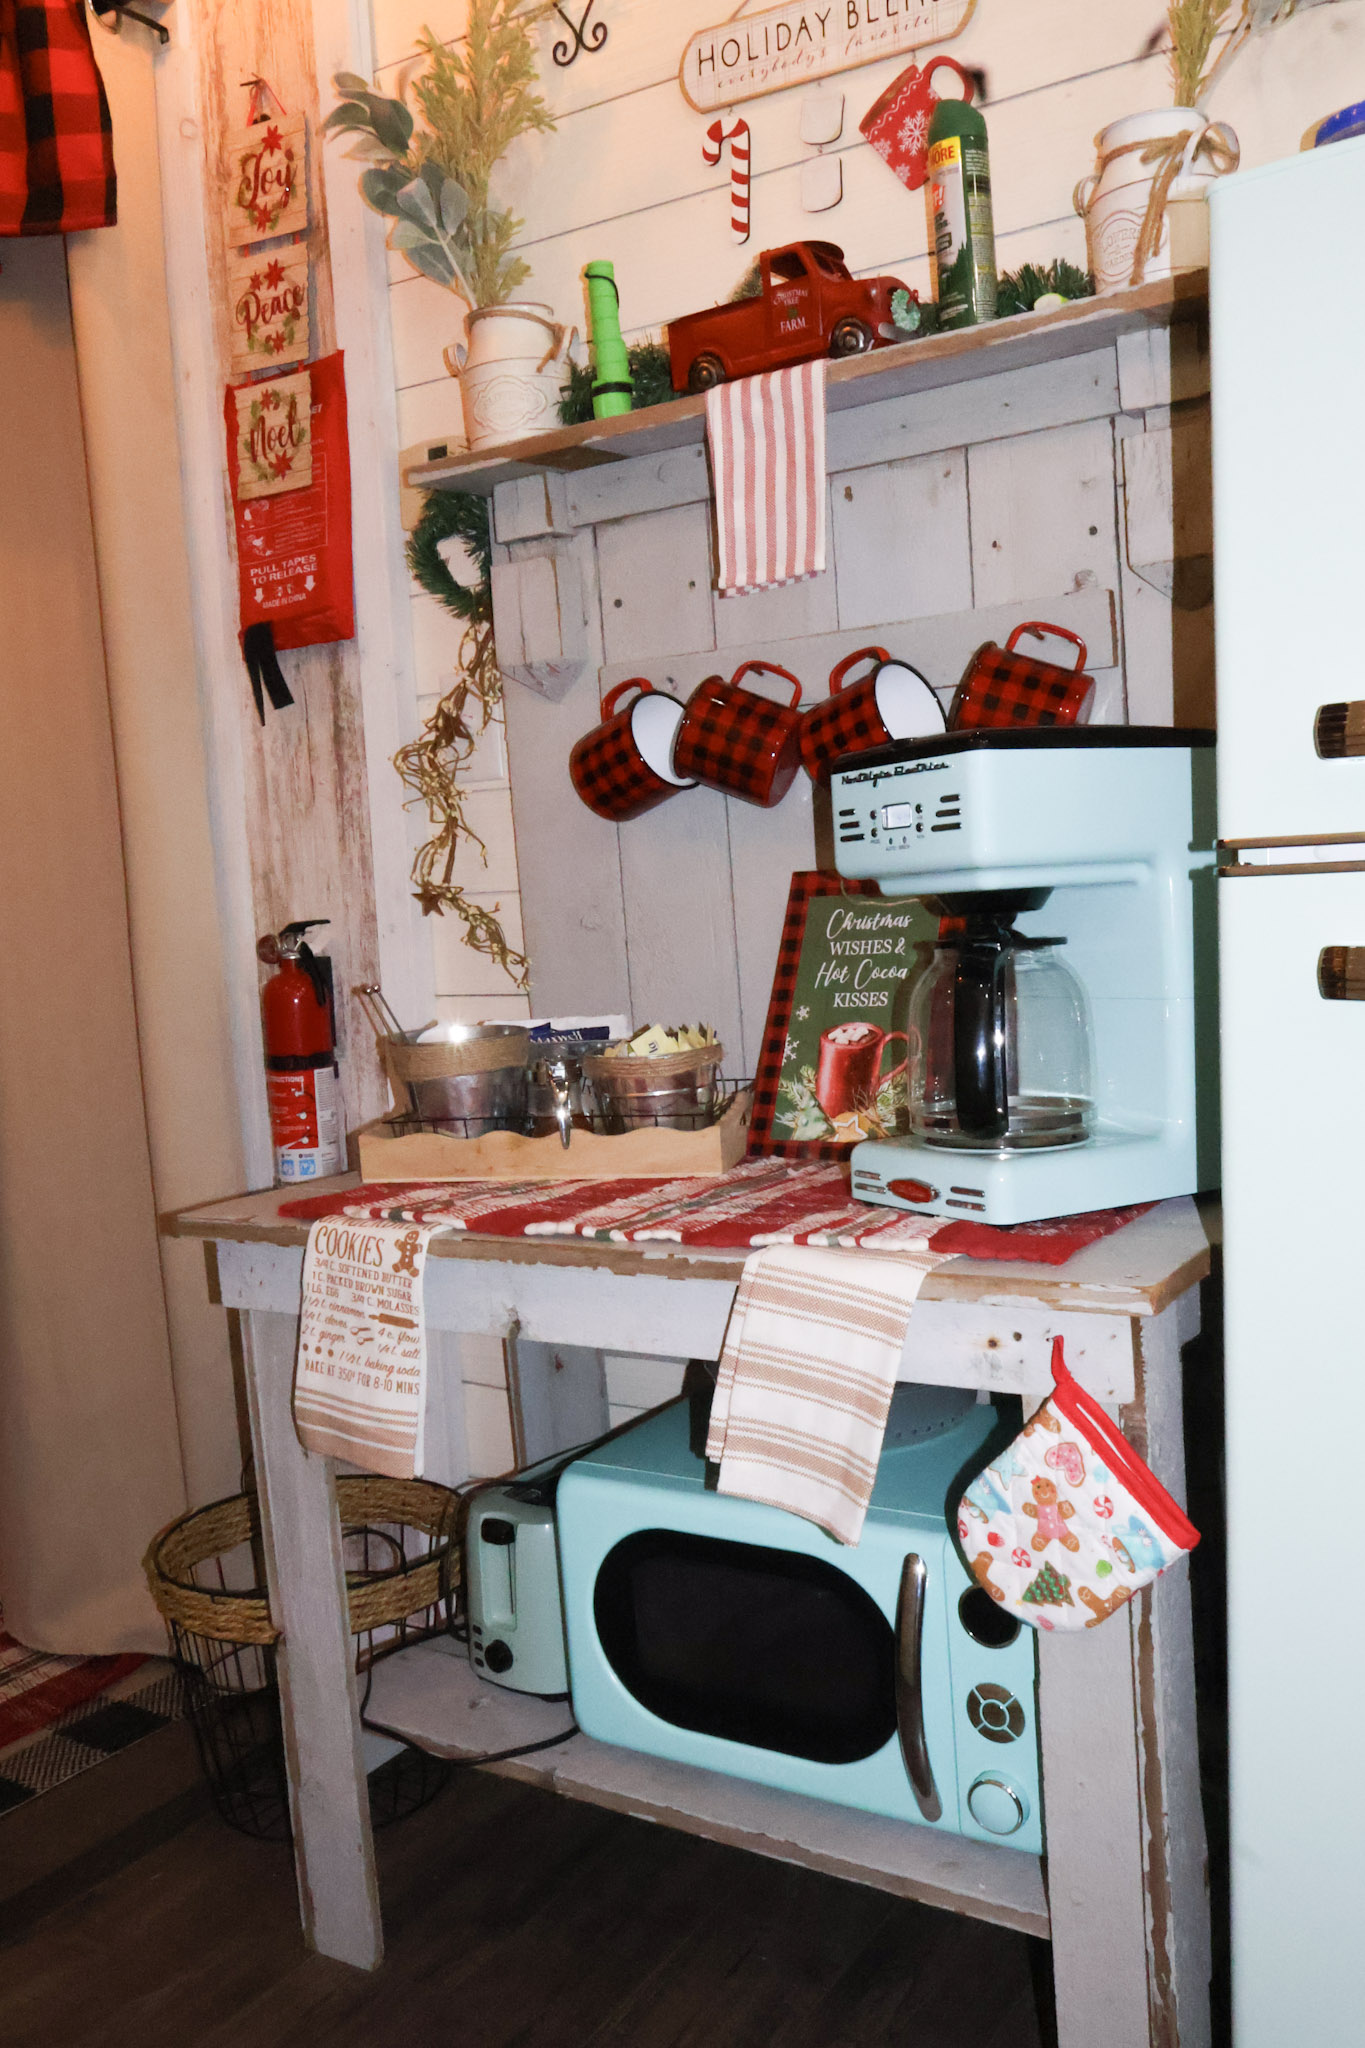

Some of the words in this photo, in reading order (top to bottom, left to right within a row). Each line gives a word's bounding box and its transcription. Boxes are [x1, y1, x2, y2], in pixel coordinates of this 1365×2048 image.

[698, 8, 831, 76] HOLIDAY
[846, 0, 940, 30] BLE
[237, 150, 297, 210] Joy
[235, 282, 305, 340] Peace
[780, 316, 806, 334] FARM
[250, 401, 300, 463] Noel
[250, 562, 278, 577] PULL
[282, 553, 317, 570] TAPES
[250, 576, 267, 585] TO
[269, 563, 318, 581] RELEASE
[826, 908, 913, 940] Christmas
[829, 939, 892, 956] WISHES
[894, 936, 906, 956] &
[814, 960, 850, 989] Hot
[854, 958, 909, 990] Cocoa
[833, 991, 889, 1008] KISSES
[315, 1226, 386, 1267] COOKIES
[327, 1273, 353, 1288] PACKED
[355, 1280, 385, 1296] BROWN
[387, 1288, 412, 1301] SUGAR
[338, 1264, 380, 1281] SOFTENED
[382, 1272, 413, 1288] BUTTER
[377, 1298, 420, 1316] MOLASSES
[304, 1358, 324, 1375] BAKE
[327, 1364, 335, 1376] AT
[357, 1371, 372, 1387] FOR
[373, 1376, 393, 1391] 8-10
[396, 1381, 421, 1396] MINS
[364, 1356, 395, 1378] baking
[396, 1365, 421, 1377] soda
